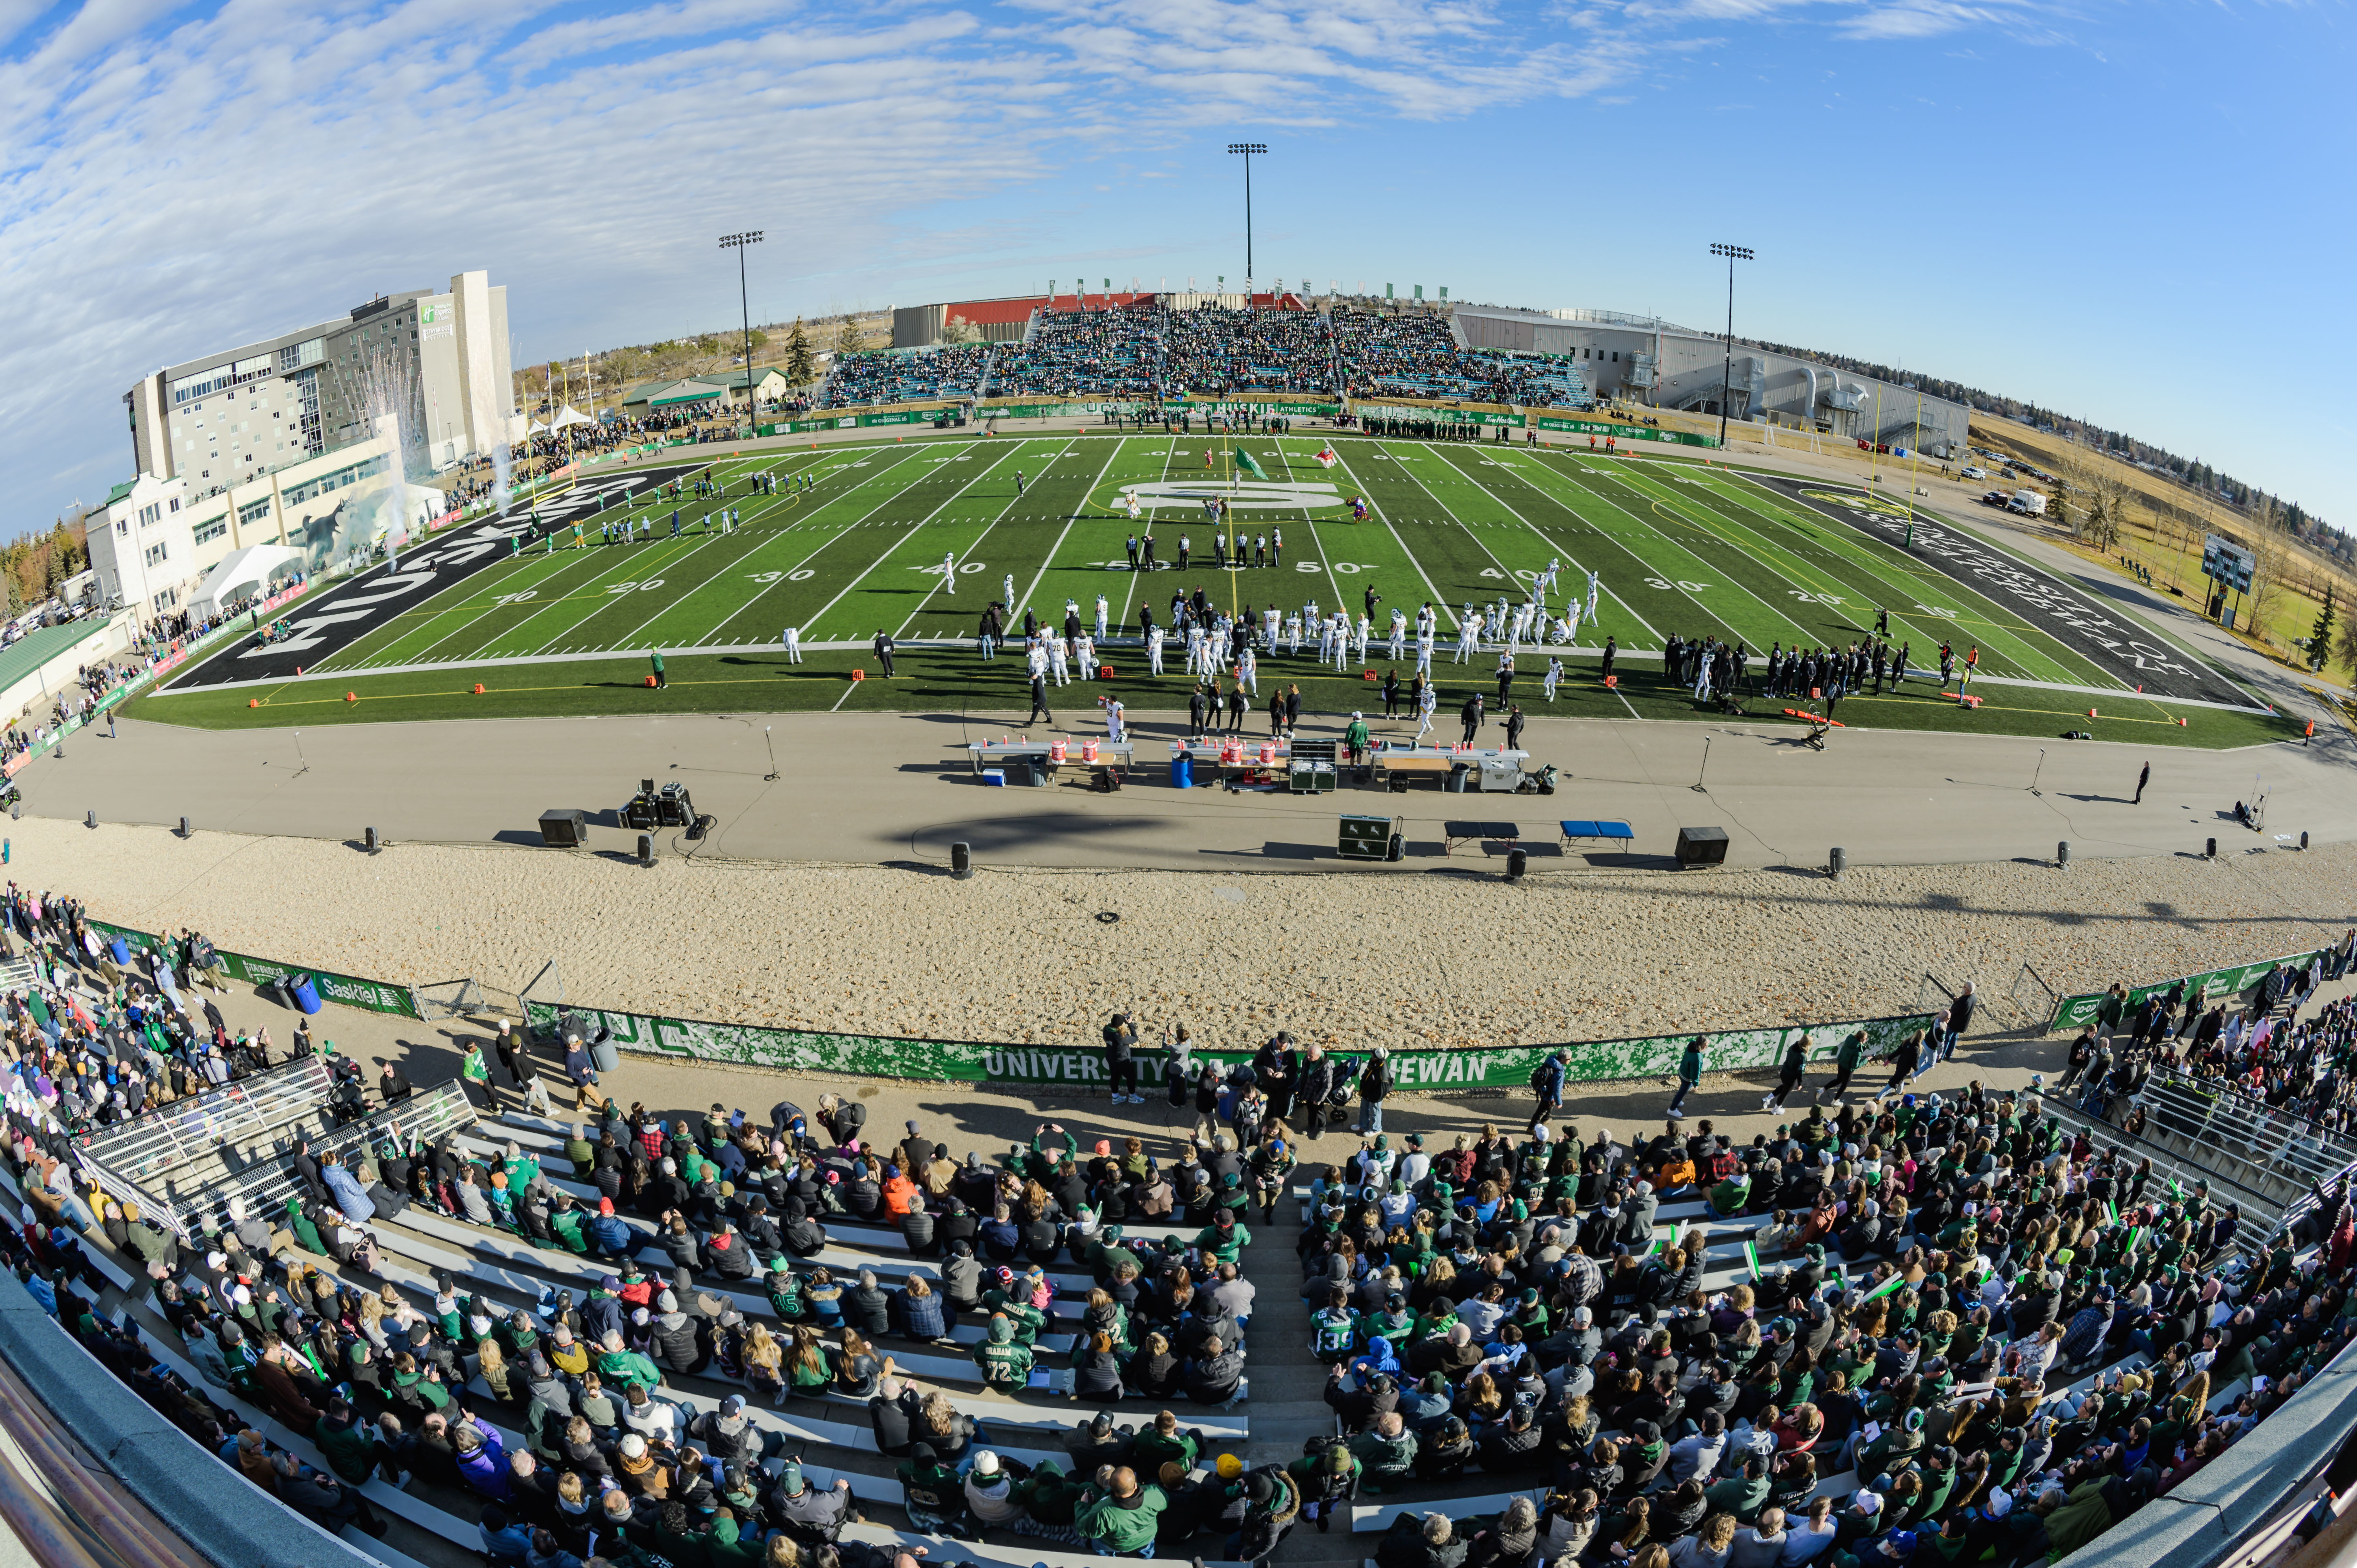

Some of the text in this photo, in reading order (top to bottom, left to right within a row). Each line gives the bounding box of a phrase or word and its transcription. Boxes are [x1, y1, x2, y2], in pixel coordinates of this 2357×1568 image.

[435, 308, 452, 317] Express
[426, 325, 450, 335] STAYBRIDGE
[1217, 403, 1275, 413] HUSKIE
[1496, 416, 1519, 425] Hortons
[1580, 424, 1603, 432] SasTel
[2211, 535, 2227, 547] UNIVERSITY
[2229, 544, 2250, 559] SASKATCHEWAN
[238, 477, 647, 659] HUSKIES
[755, 569, 816, 584] 30
[607, 578, 665, 593] 20
[1644, 577, 1705, 593] 30
[1849, 510, 2168, 675] SASKATCHEWAN
[1788, 589, 1842, 606] 20
[1896, 518, 2201, 680] UNIVERSITY OF
[187, 625, 229, 654] LIVE #HuskiePride
[1103, 669, 1112, 677] 50
[1366, 671, 1376, 680] 50
[125, 675, 144, 692] SaskTel
[1609, 678, 1617, 686] 40
[249, 963, 281, 977] STAYBRIDGE
[323, 978, 378, 1005] SaskTel
[2074, 1004, 2098, 1015] CO-OP
[985, 1050, 1168, 1082] UNIVERSTY
[772, 1294, 799, 1313] 45
[1613, 1294, 1635, 1305] RAMS
[1002, 1300, 1026, 1317] GRAHAM
[1324, 1330, 1354, 1351] 39
[986, 1347, 1011, 1356] GRAHAM
[987, 1361, 1012, 1382] 72
